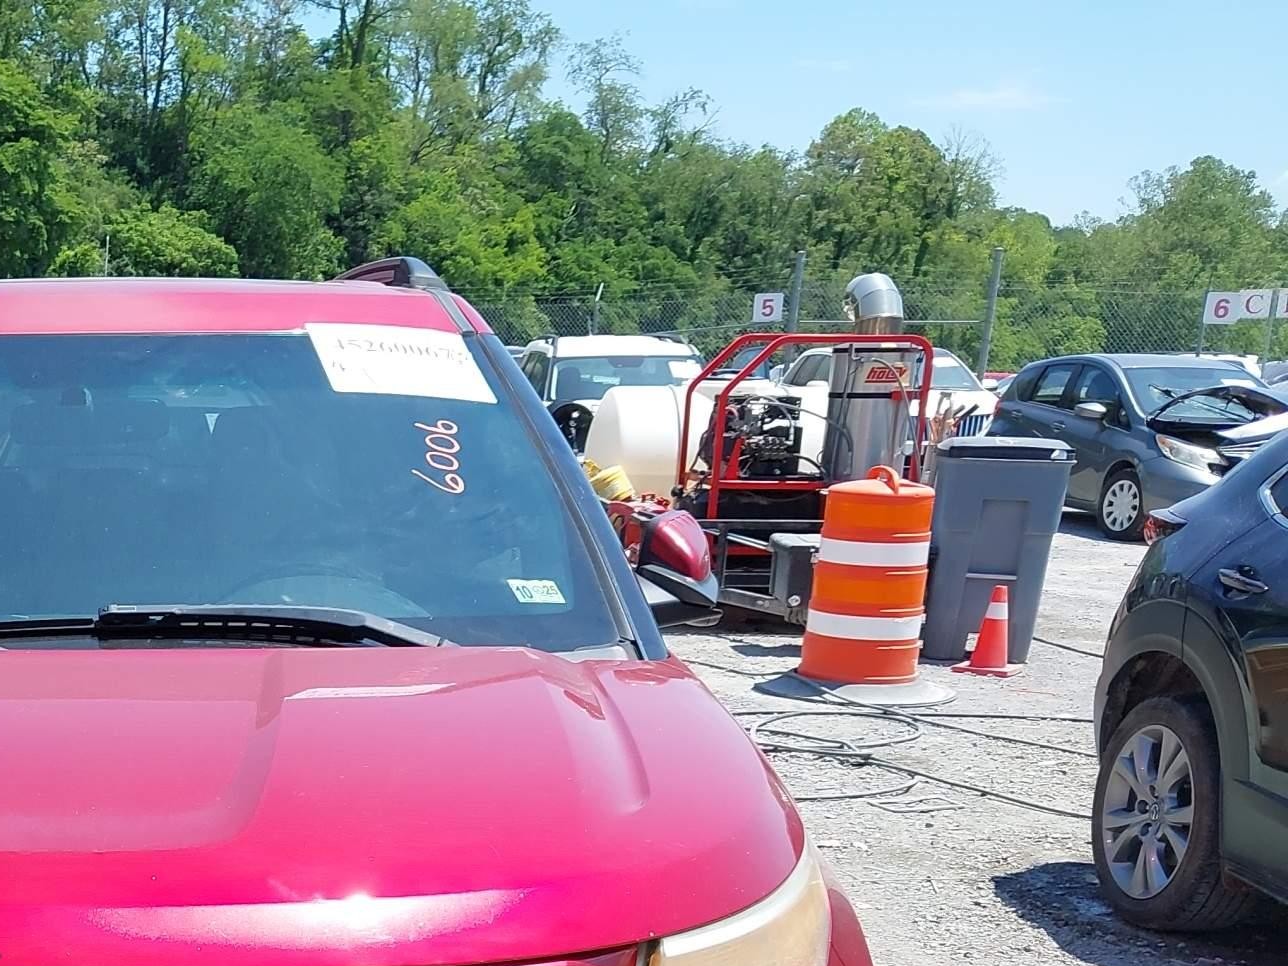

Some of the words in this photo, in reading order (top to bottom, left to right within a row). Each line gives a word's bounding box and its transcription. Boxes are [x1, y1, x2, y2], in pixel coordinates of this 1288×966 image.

[761, 299, 774, 317] 5
[1214, 298, 1231, 319] 6
[1245, 294, 1264, 314] C
[411, 419, 465, 494] 6006
[515, 585, 534, 599] 10
[542, 585, 558, 595] 25
